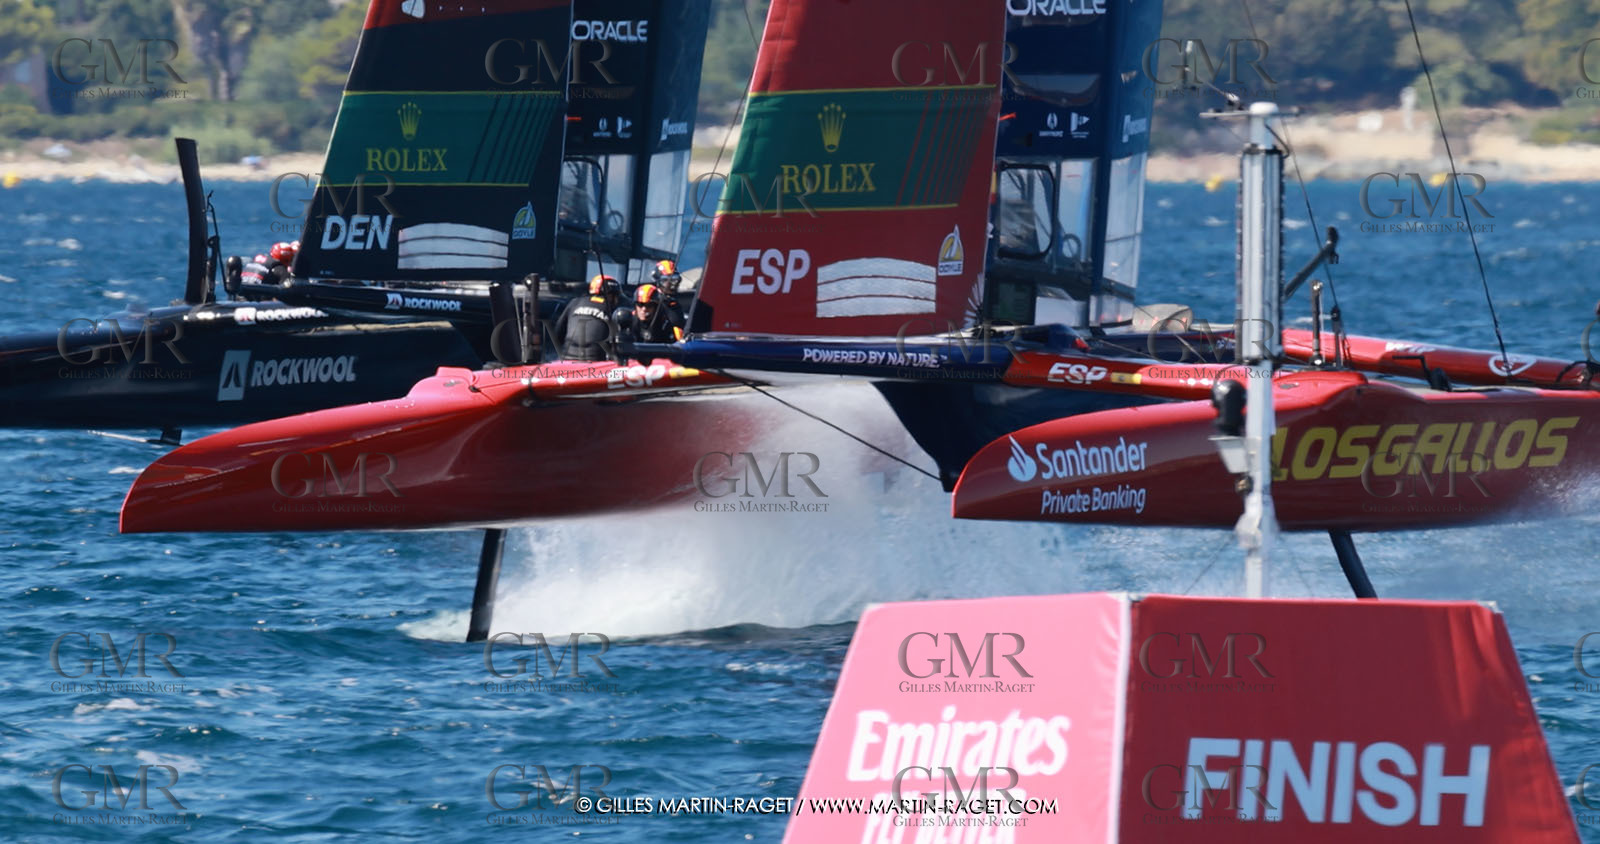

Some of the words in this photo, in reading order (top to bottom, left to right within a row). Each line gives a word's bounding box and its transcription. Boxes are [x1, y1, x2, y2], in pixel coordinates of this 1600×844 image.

[1006, 0, 1106, 16] ORACLE
[572, 20, 648, 41] ORACLE
[366, 148, 448, 172] ROLEX
[781, 161, 876, 195] ROLEX
[320, 213, 395, 251] DEN
[730, 248, 811, 295] ESP
[404, 297, 462, 312] ROCKWOOL
[251, 355, 357, 387] ROCKWOOL
[802, 348, 867, 364] POWERED
[868, 351, 886, 364] BY
[606, 364, 666, 389] ESP
[1047, 362, 1108, 385] ESP
[1036, 436, 1147, 479] Santander
[1041, 488, 1091, 514] Private
[1091, 484, 1147, 514] Banking
[846, 705, 1072, 781] Emirates
[1182, 737, 1491, 827] FINISH
